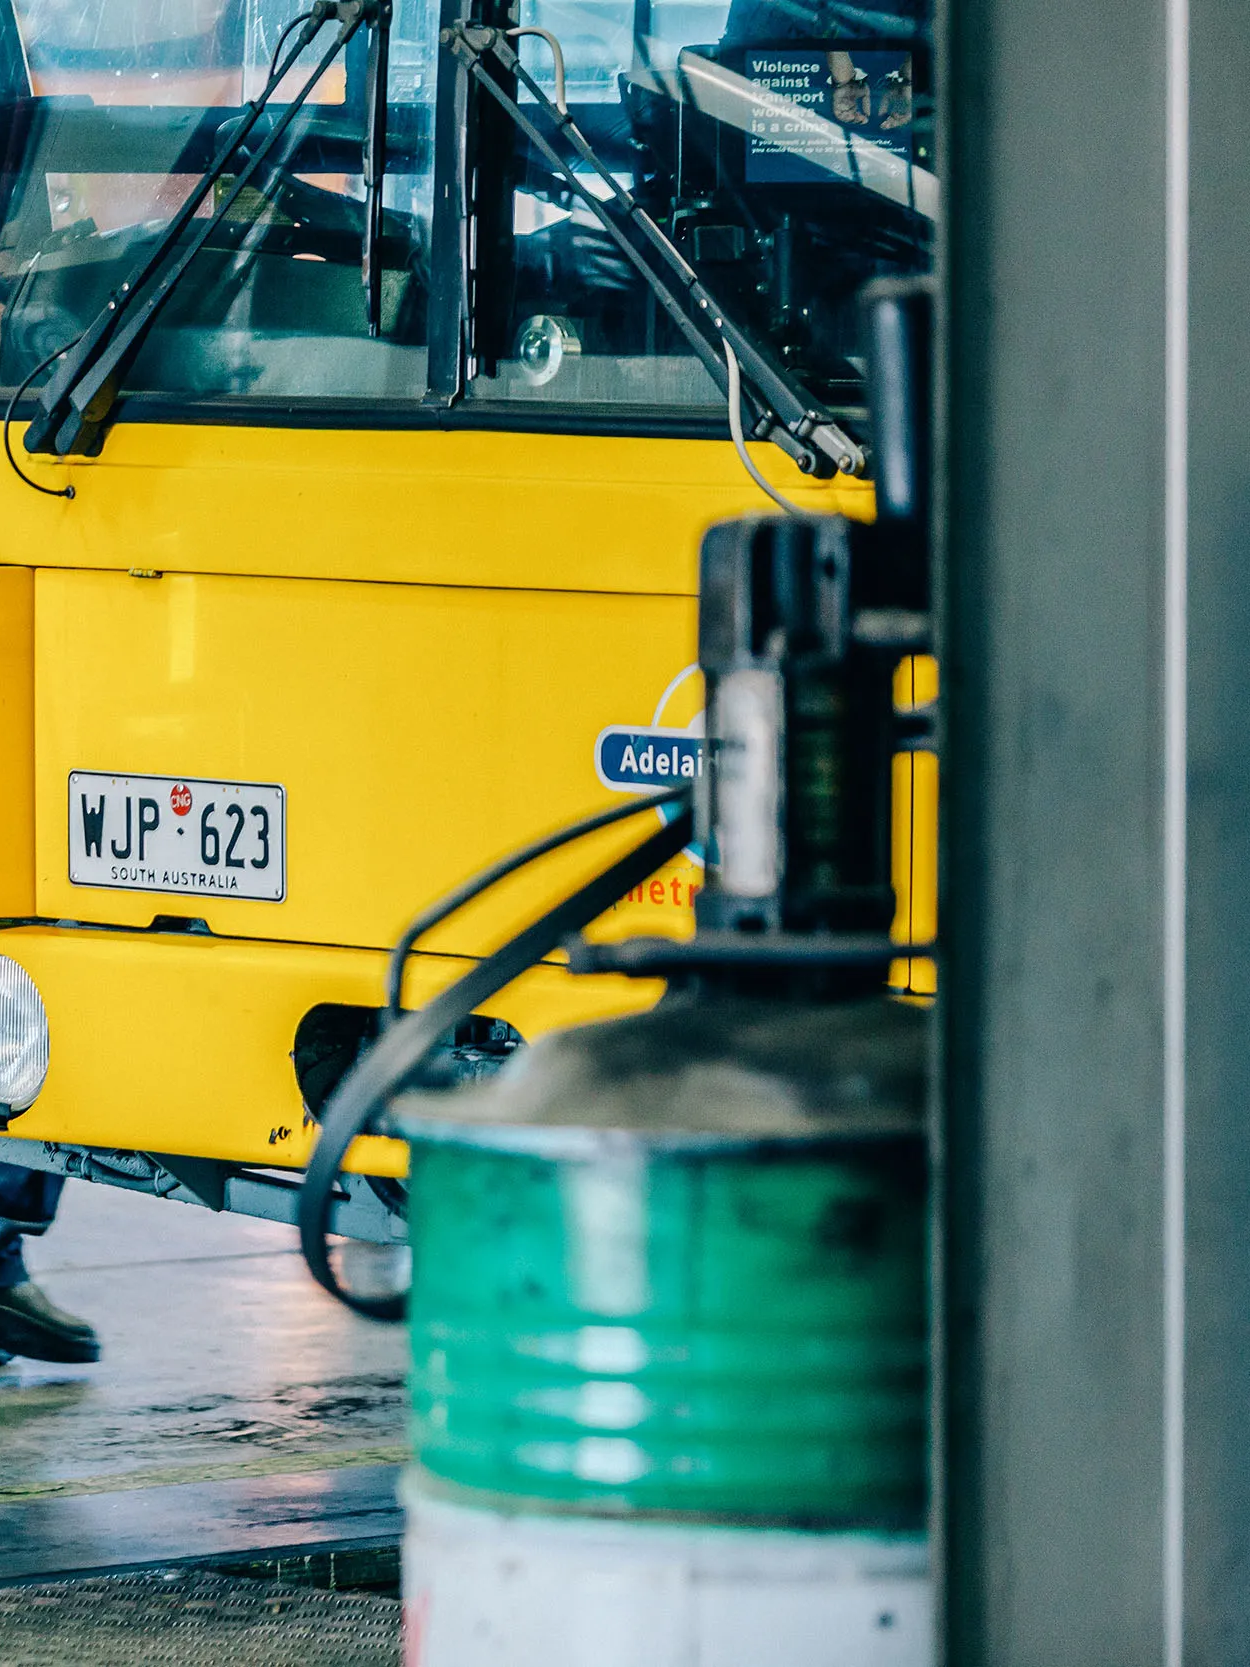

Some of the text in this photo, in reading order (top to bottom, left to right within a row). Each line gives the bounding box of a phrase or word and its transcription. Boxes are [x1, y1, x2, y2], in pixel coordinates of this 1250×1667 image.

[752, 60, 820, 73] Violence
[752, 75, 810, 90] against
[752, 91, 825, 104] transport
[752, 106, 816, 118] workers
[751, 119, 829, 133] is a crime
[619, 744, 703, 777] Adelai
[170, 793, 191, 808] CNG
[81, 793, 269, 869] WJP 623
[111, 866, 238, 890] SOUTH AUSTRALIA
